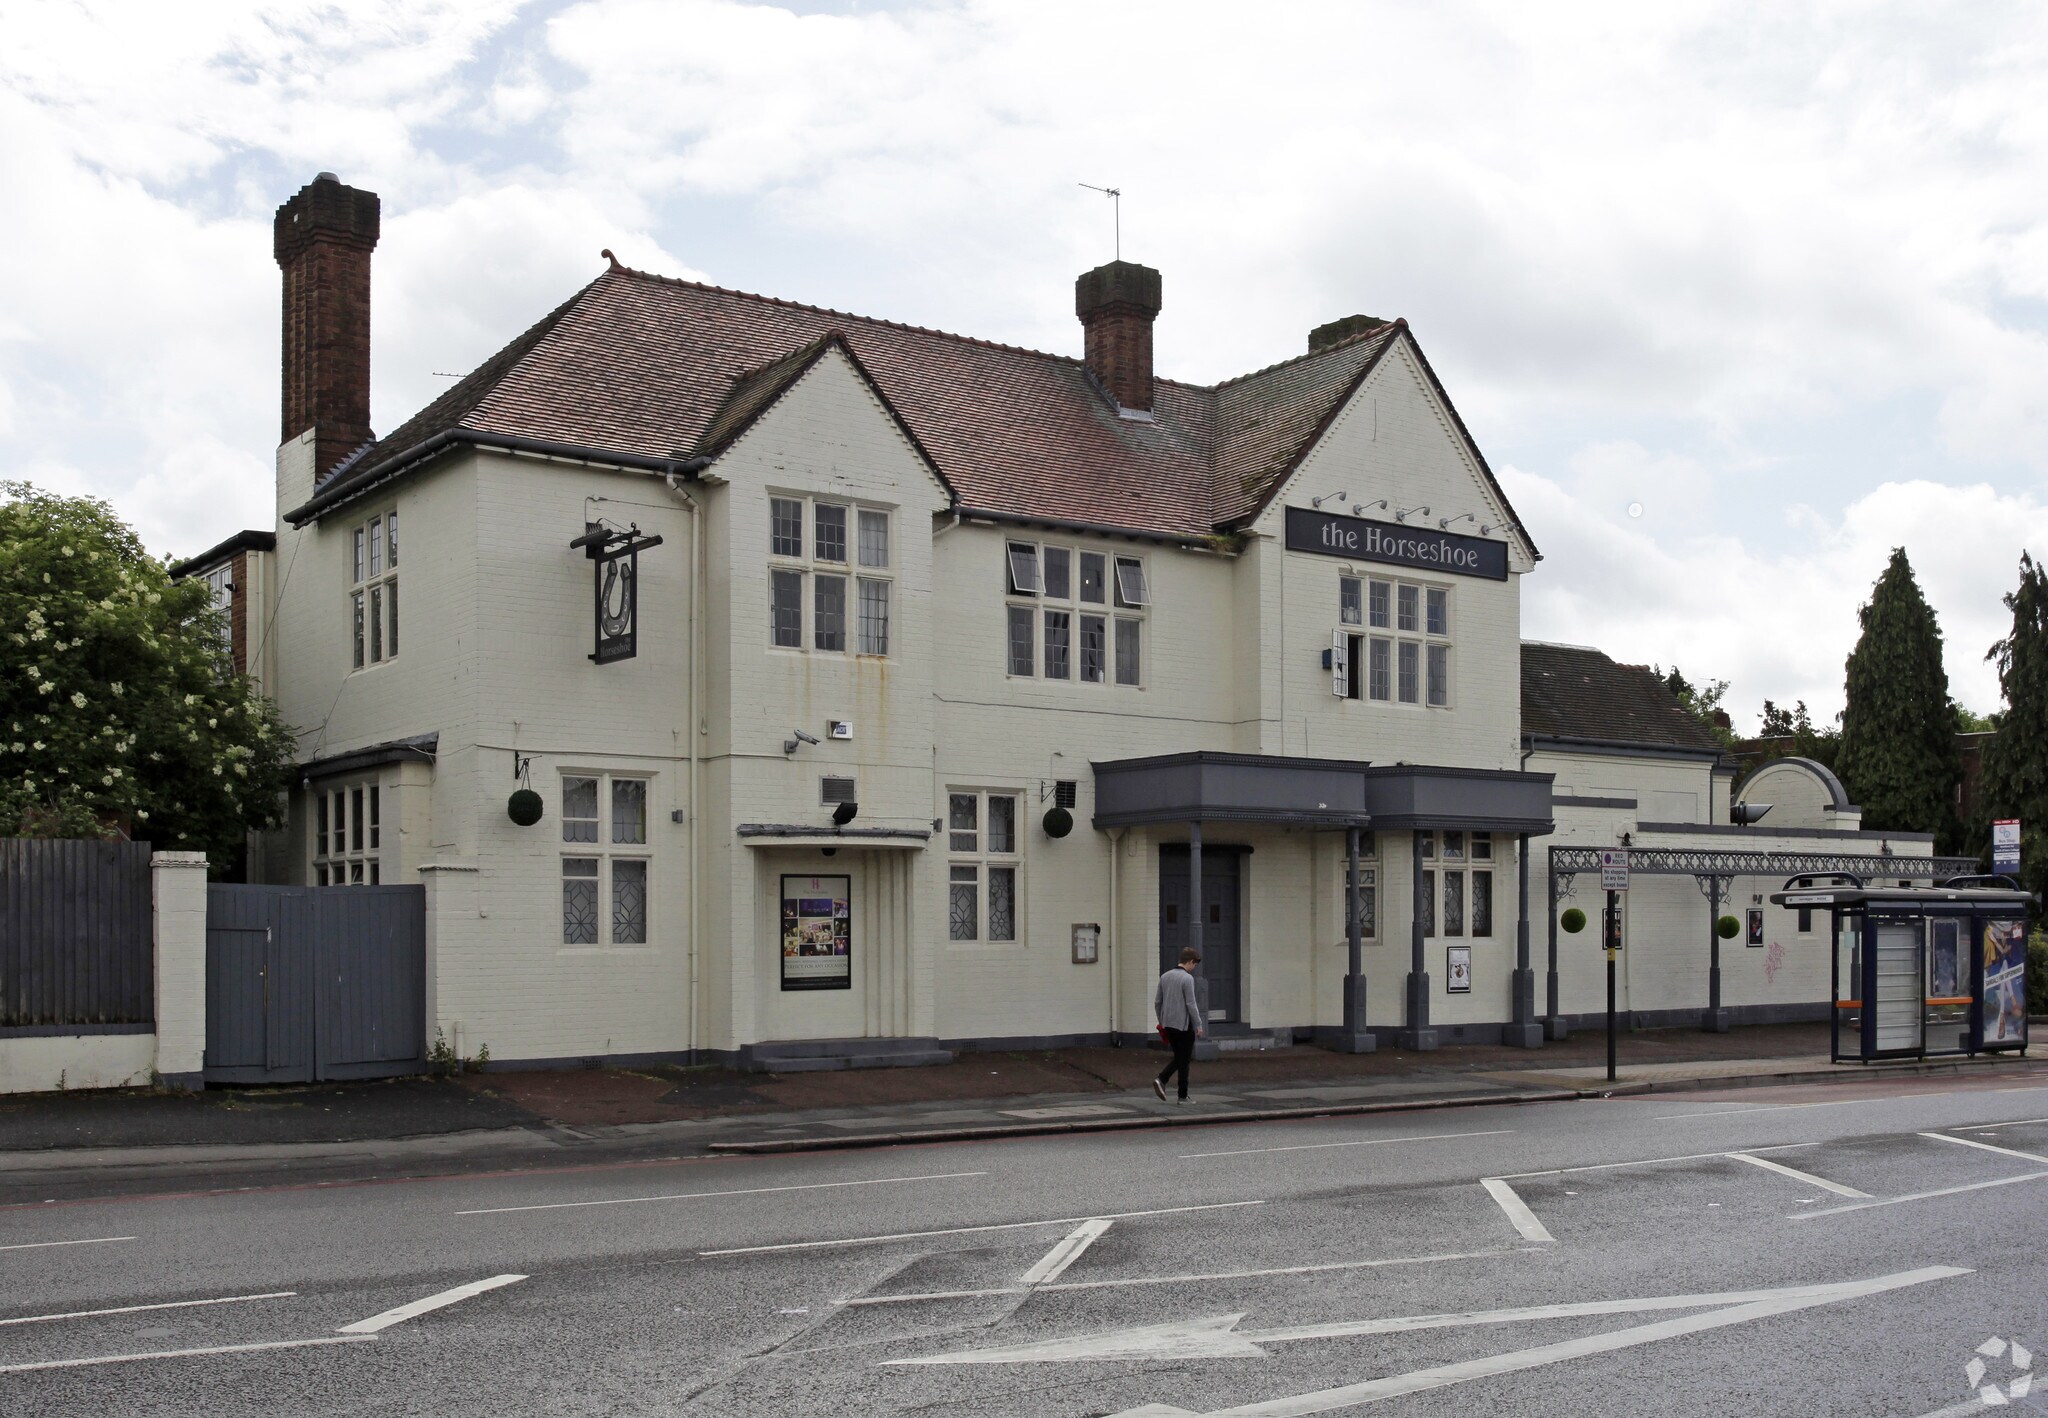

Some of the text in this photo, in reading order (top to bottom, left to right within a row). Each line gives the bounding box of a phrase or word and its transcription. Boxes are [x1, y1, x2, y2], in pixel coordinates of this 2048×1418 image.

[1322, 522, 1478, 568] the Horseshoe
[600, 643, 631, 657] Horseshoe
